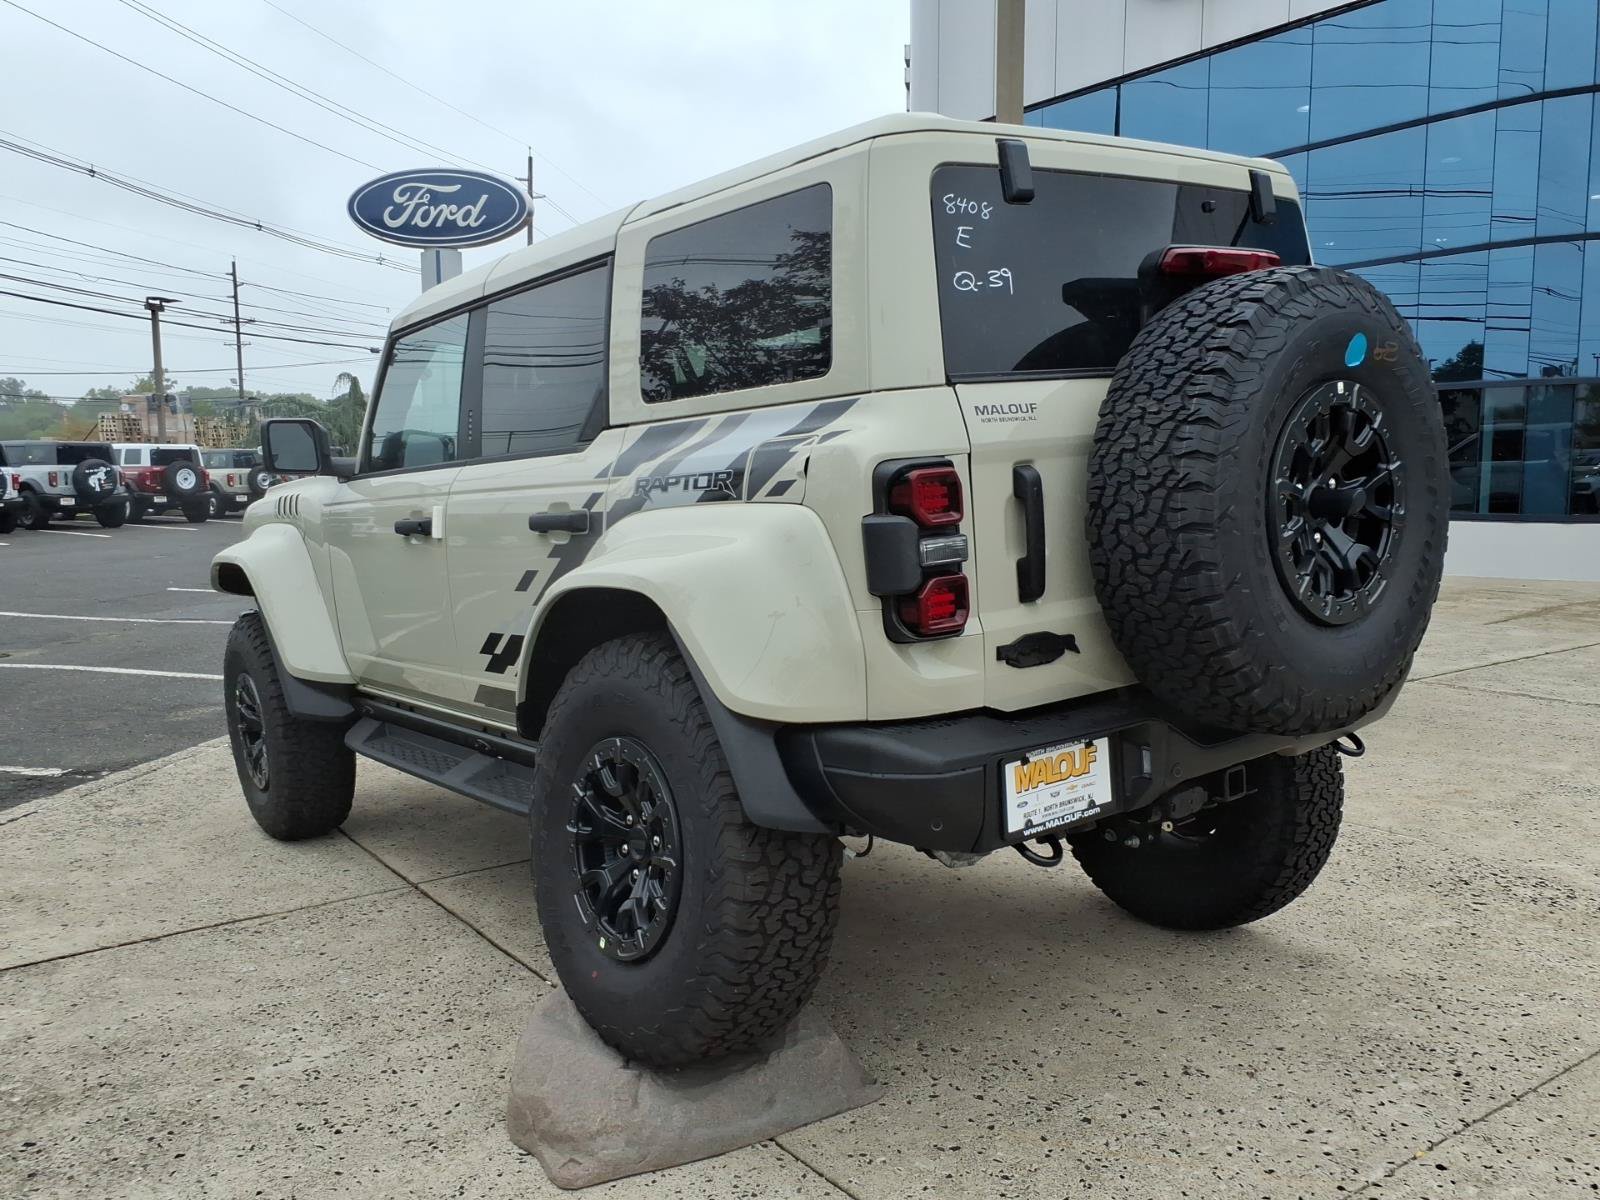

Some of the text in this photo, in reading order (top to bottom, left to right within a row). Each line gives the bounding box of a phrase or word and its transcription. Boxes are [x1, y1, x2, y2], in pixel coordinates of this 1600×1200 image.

[383, 182, 489, 228] Ford
[942, 193, 994, 220] 8408
[956, 226, 974, 249] E
[974, 402, 1038, 417] MALOUF
[634, 469, 737, 503] RAPTOR
[1015, 745, 1097, 794] MALOUF
[1023, 806, 1101, 837] www.MALOUF.com
